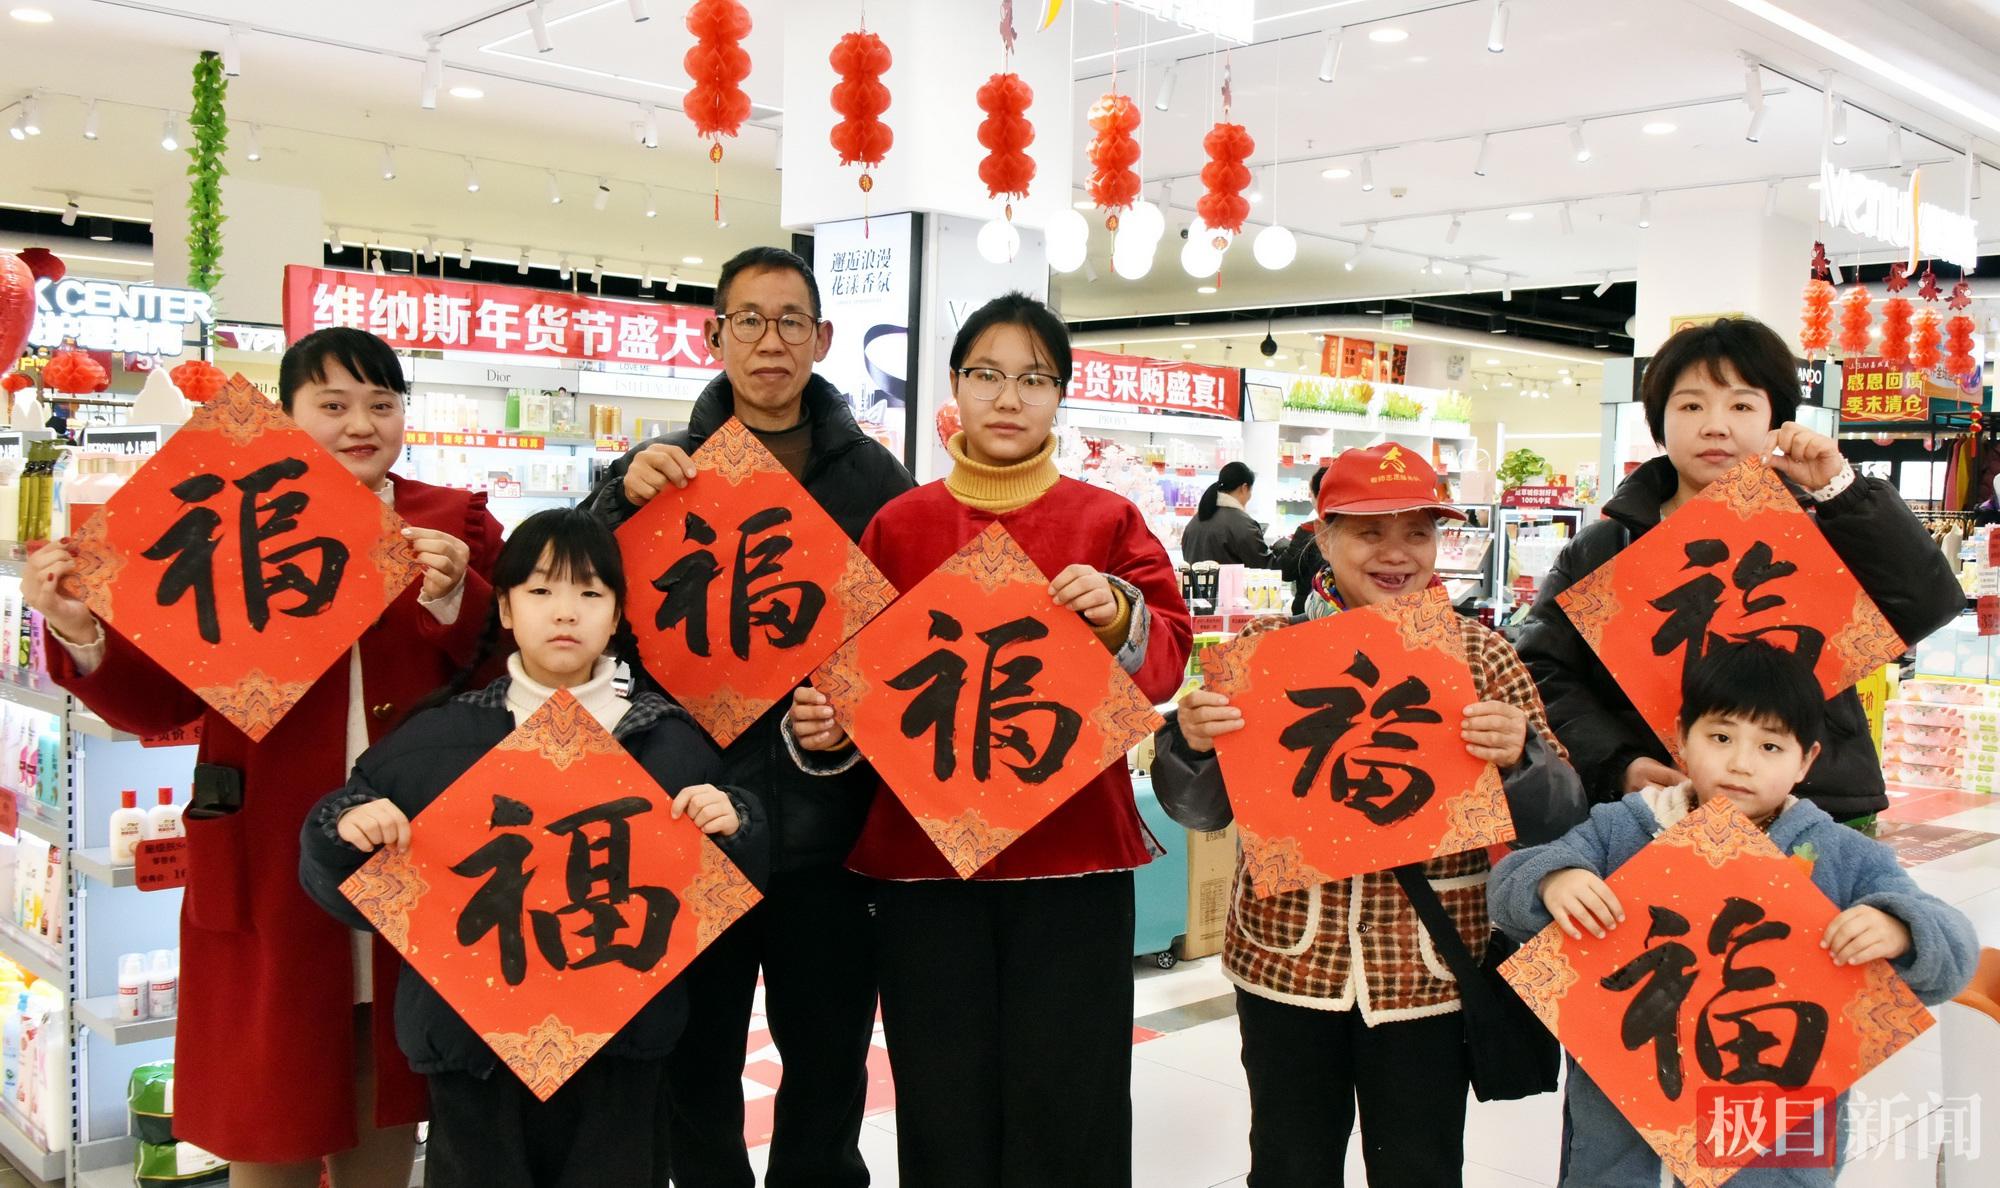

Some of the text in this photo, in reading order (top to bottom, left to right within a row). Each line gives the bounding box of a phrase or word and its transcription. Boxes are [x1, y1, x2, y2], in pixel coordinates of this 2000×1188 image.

[830, 248, 892, 273] 邂逅浪漫
[832, 271, 891, 296] 花漾香氛
[56, 281, 214, 324] CENTER
[313, 283, 722, 365] 维纳斯年货节盛大
[487, 369, 511, 382] Dior
[1845, 396, 1922, 414] 季末清仓
[1847, 373, 1922, 392] 感恩回馈
[142, 459, 349, 643] 福
[650, 506, 829, 661] 福
[884, 609, 1083, 784] 福
[1280, 650, 1441, 827] 福
[448, 795, 682, 985] 福
[1600, 897, 1830, 1100] 福
